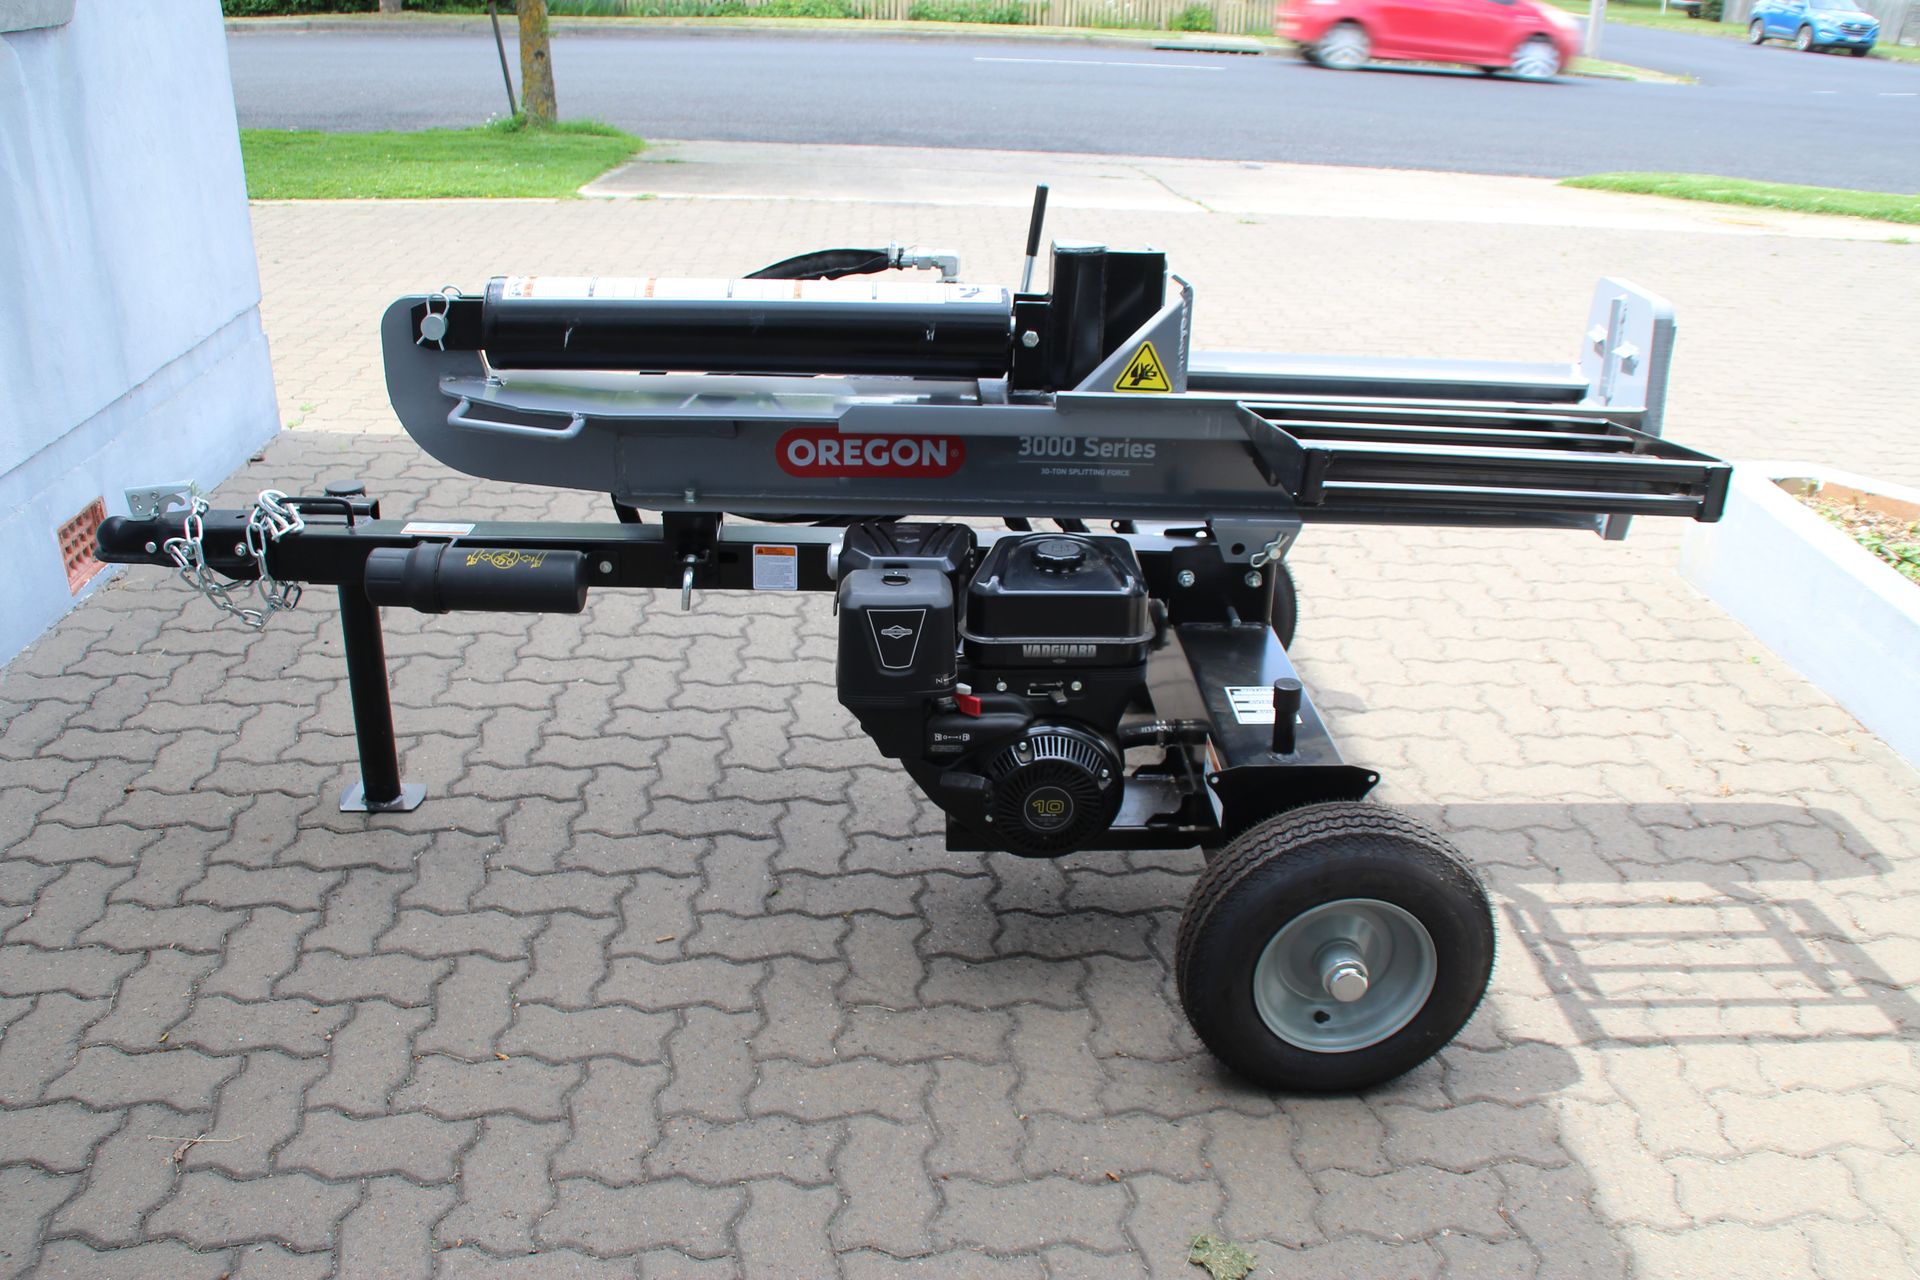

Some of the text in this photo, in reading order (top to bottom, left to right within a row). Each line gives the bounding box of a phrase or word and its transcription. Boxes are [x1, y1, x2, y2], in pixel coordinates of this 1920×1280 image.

[1018, 436, 1157, 459] 3000 Series
[1040, 467, 1130, 477] 30-TON SPLITTING FORCE
[1022, 644, 1097, 658] VANGUARD
[1032, 799, 1065, 814] 10
